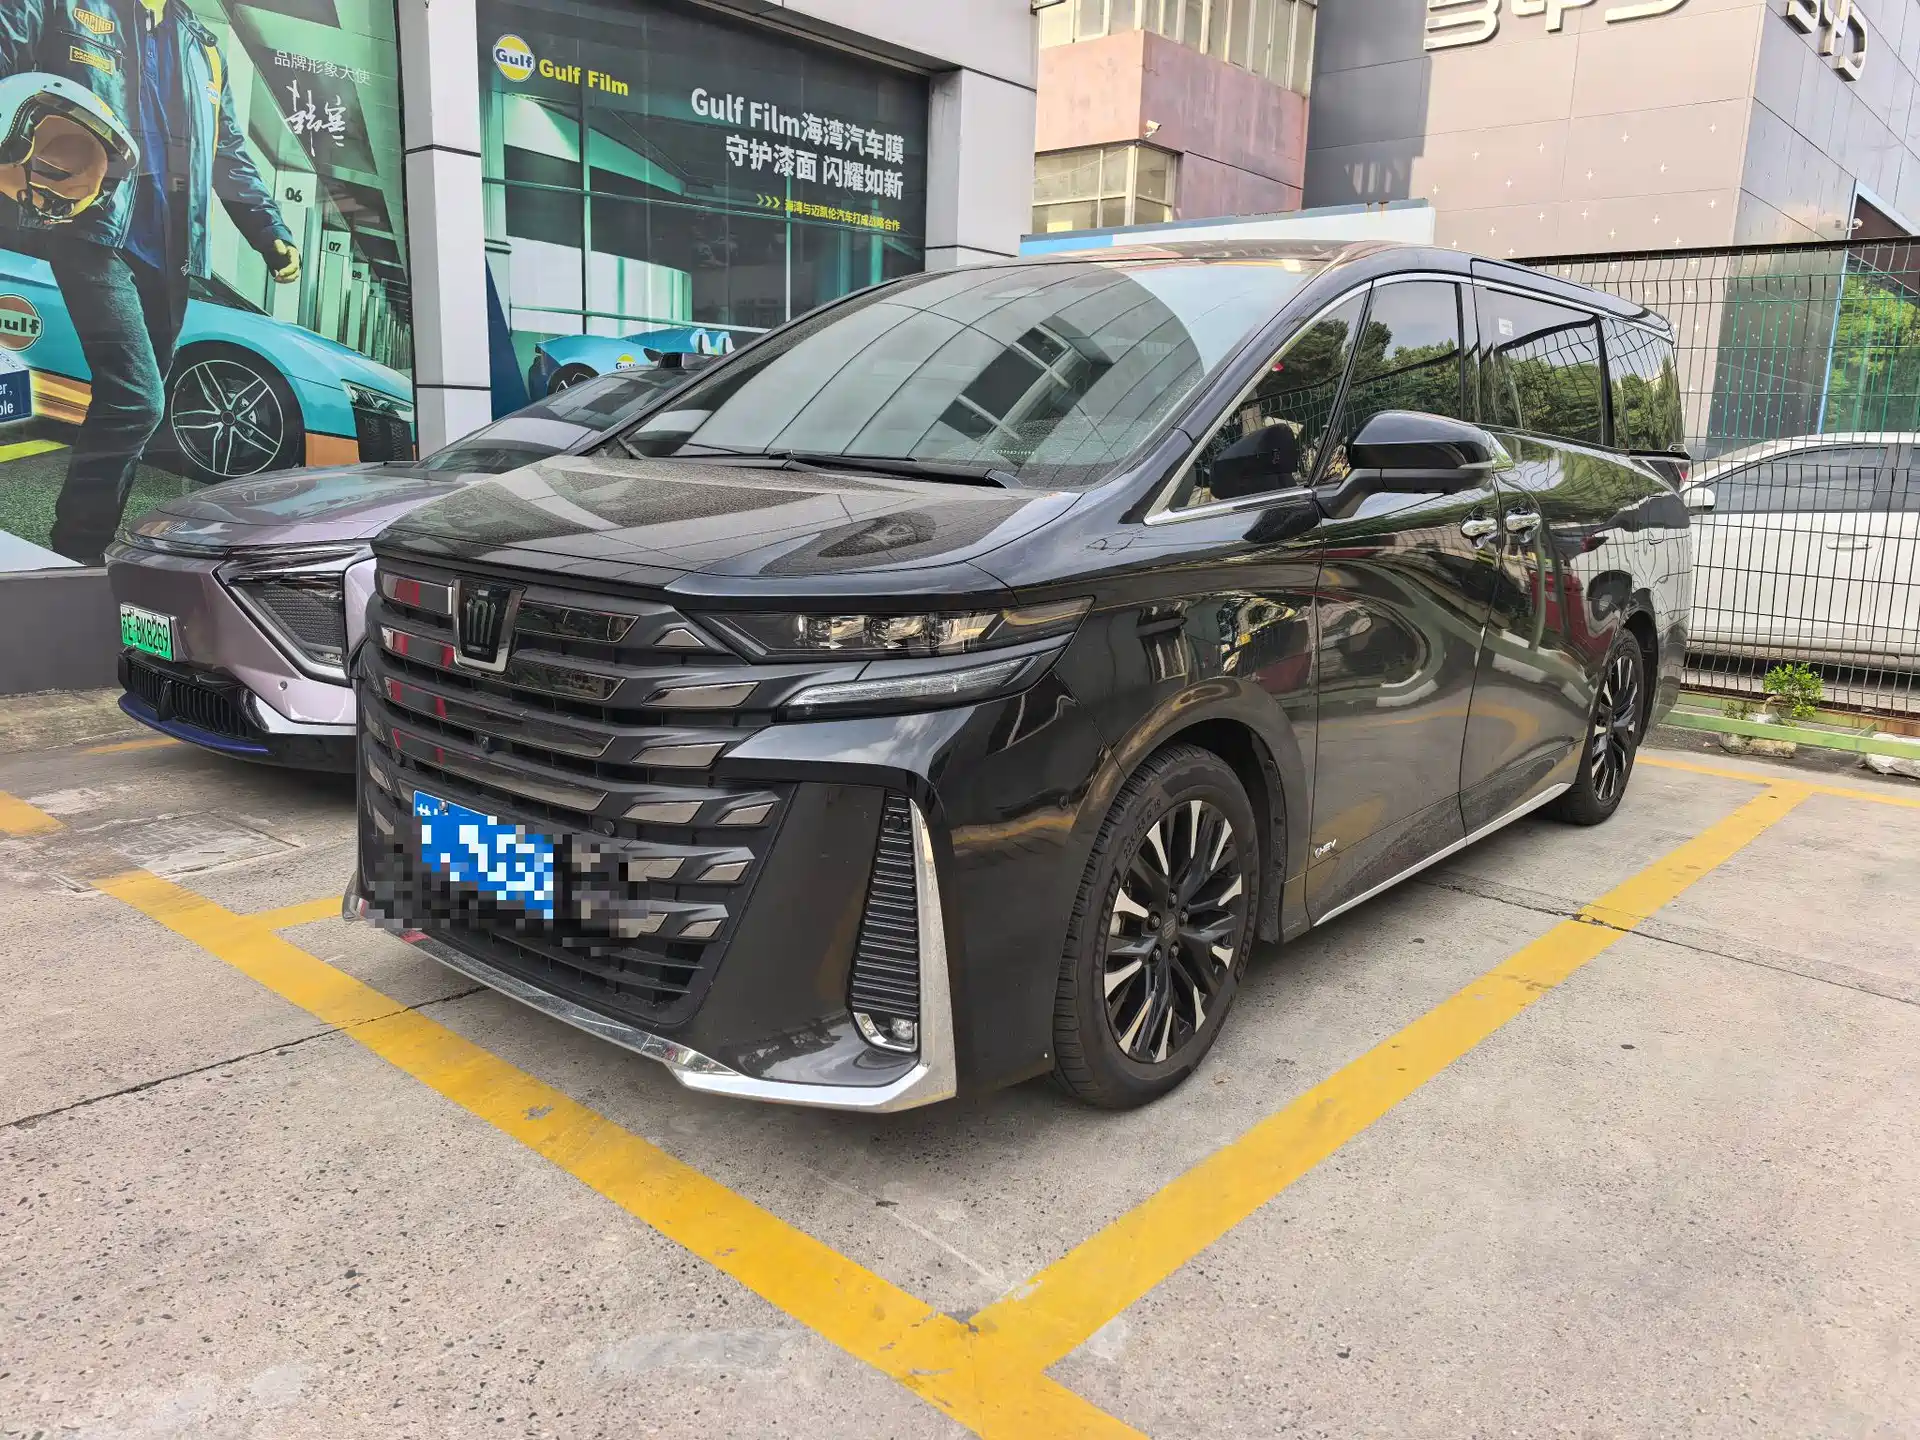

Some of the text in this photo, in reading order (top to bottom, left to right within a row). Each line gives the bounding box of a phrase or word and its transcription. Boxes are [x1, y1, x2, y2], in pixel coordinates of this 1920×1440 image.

[274, 49, 372, 87] 品牌形象大使
[495, 48, 532, 68] Gulf
[538, 58, 629, 96] Gulf Film
[691, 87, 744, 125] Gulf
[726, 134, 904, 200] 守护漆面 闪耀如新
[285, 187, 303, 202] 06
[328, 241, 341, 252] 07
[0, 316, 40, 335] ulf
